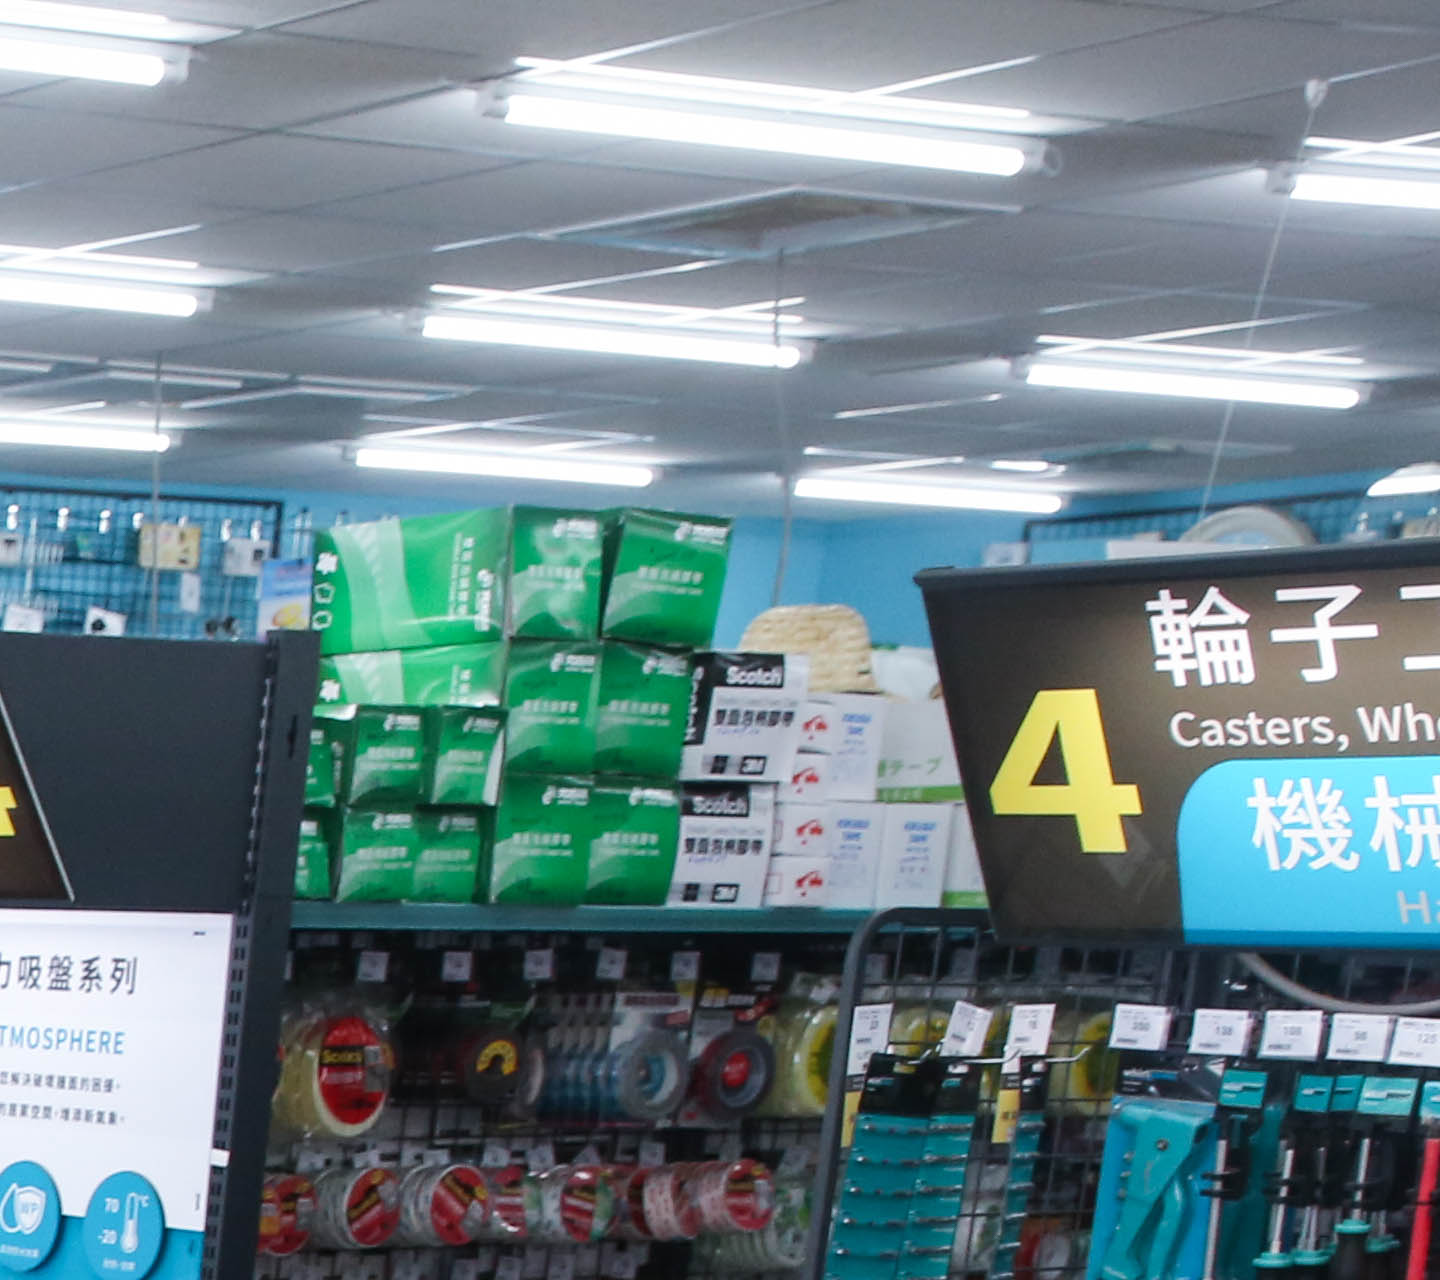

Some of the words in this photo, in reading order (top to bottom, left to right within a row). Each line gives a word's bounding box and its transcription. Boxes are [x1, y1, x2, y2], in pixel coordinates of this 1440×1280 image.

[726, 664, 782, 687] Scotch
[1169, 710, 1350, 752] Casters,
[1356, 702, 1440, 743] Wh
[989, 687, 1142, 854] 4
[693, 795, 748, 815] Scotch
[1396, 890, 1440, 925] H
